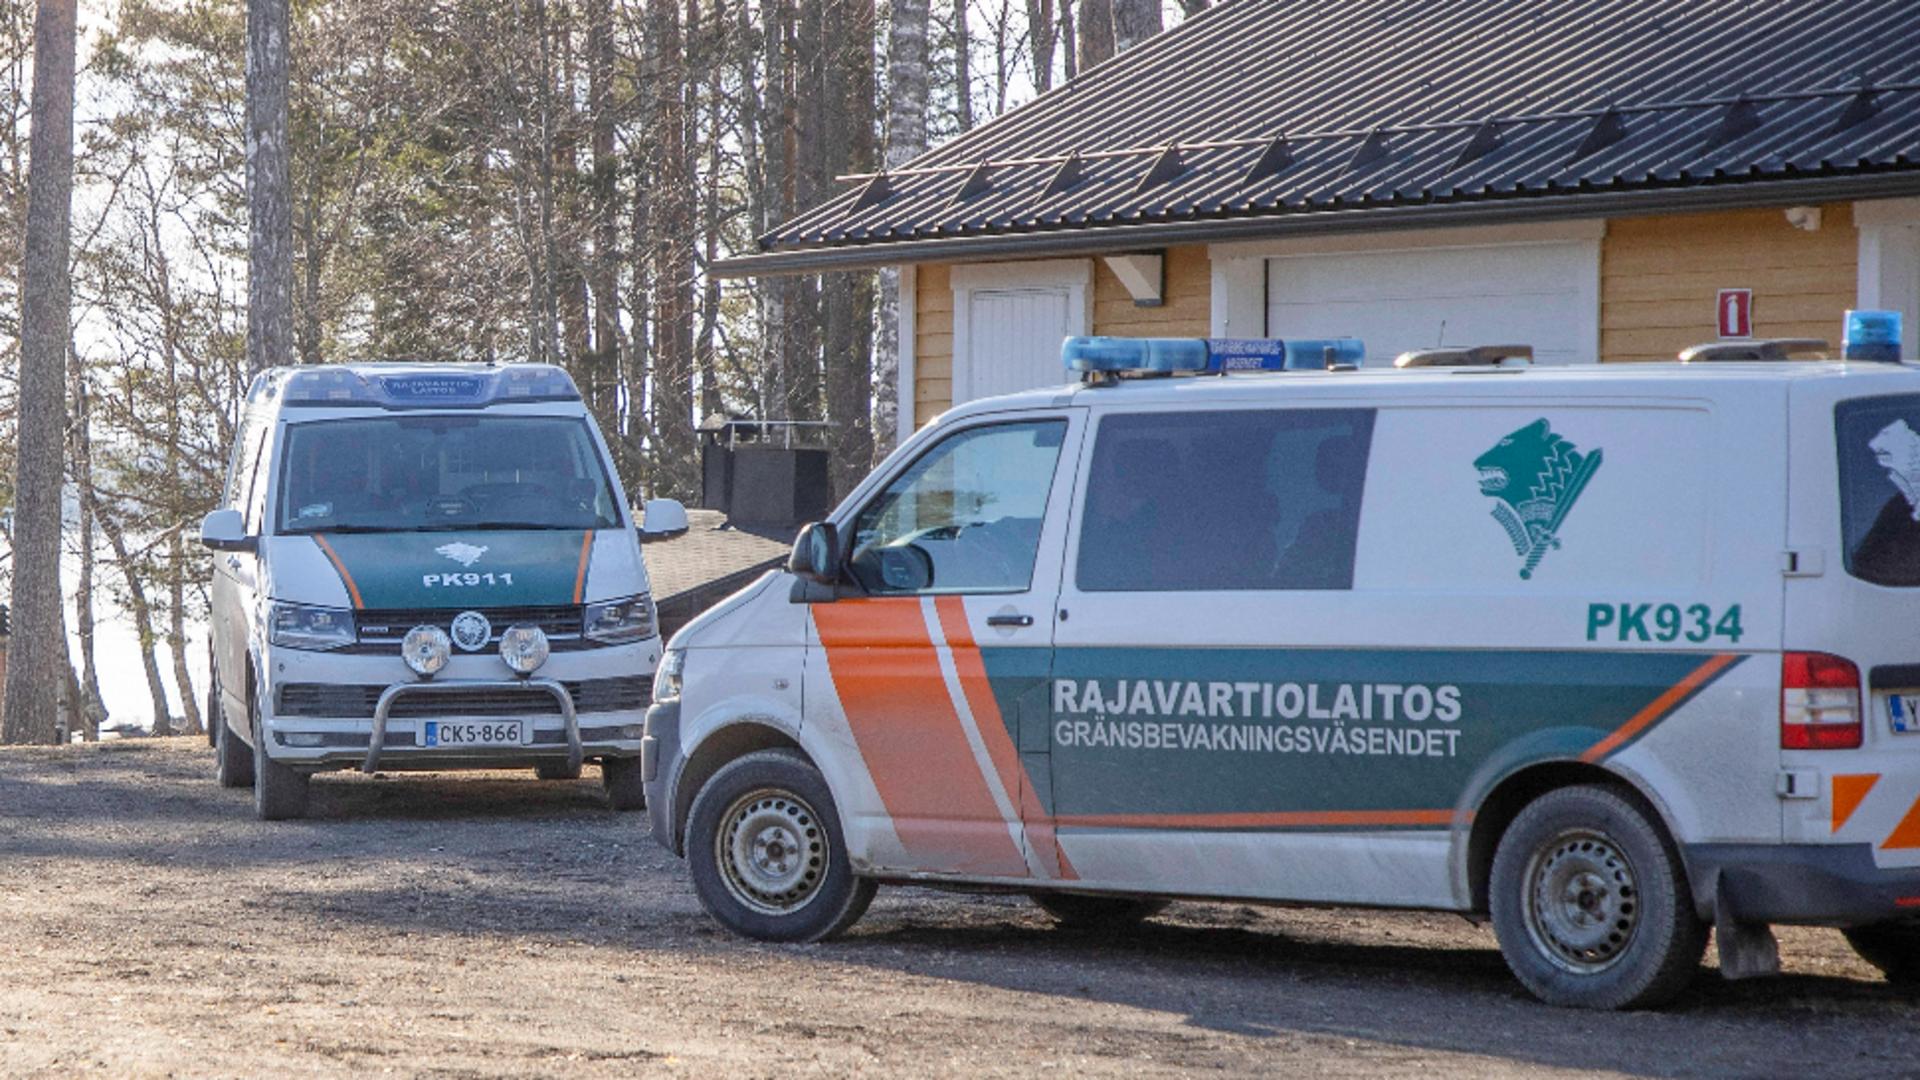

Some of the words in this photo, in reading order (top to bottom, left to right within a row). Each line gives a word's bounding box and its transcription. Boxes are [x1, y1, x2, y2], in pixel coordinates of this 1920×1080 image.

[423, 572, 512, 587] PK911
[1586, 602, 1743, 643] PK934
[1054, 679, 1461, 722] RAJAVARTIOLAITOS
[440, 724, 518, 742] CK5-866
[1055, 715, 1461, 757] GRÄNSBEVAKNINGSVÄSENDET
